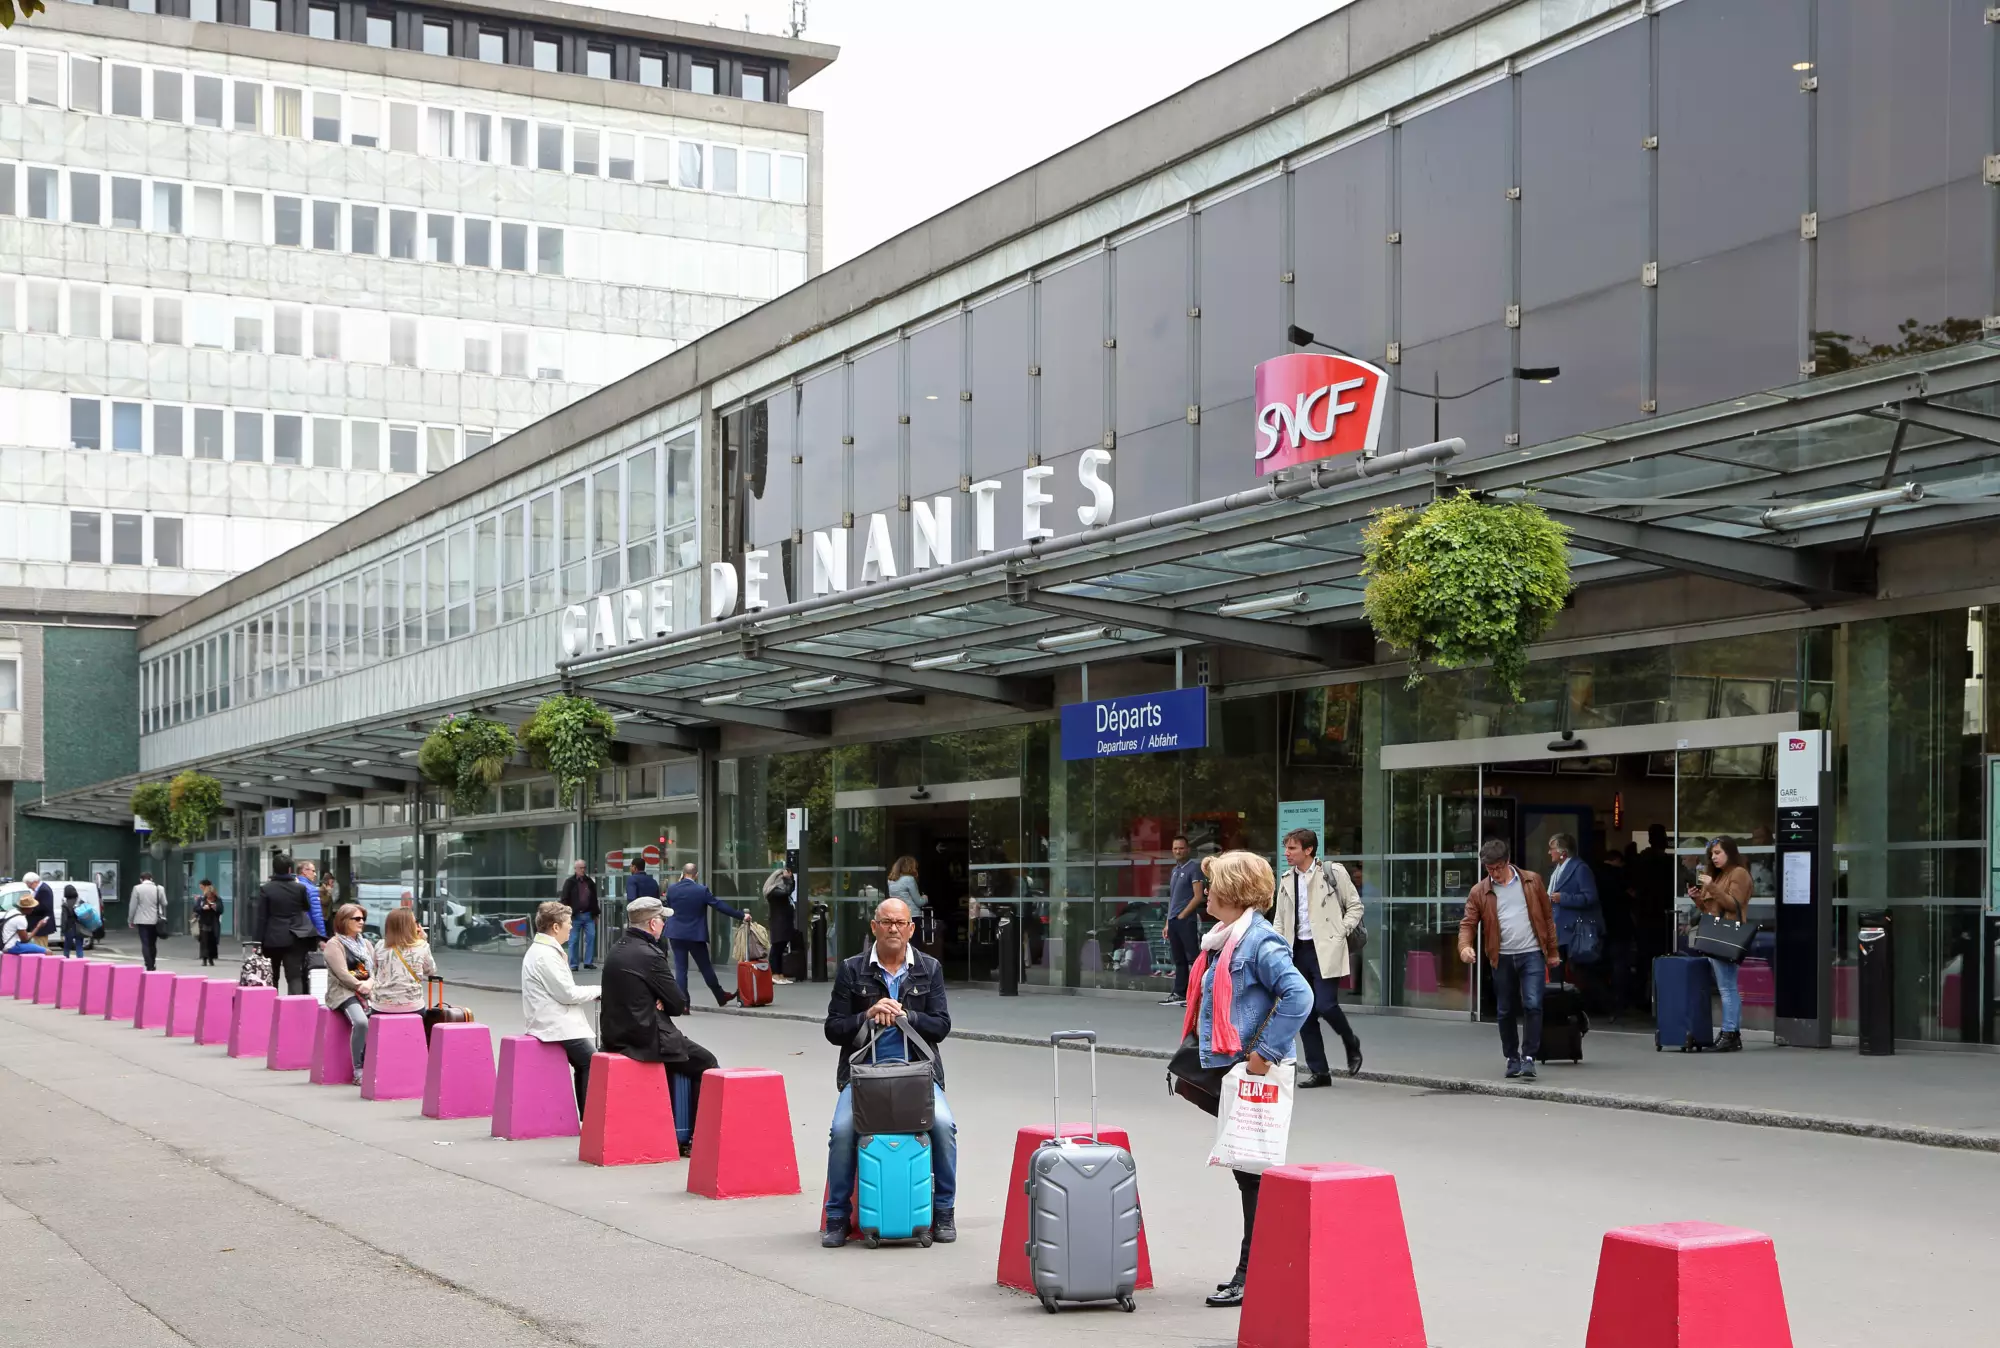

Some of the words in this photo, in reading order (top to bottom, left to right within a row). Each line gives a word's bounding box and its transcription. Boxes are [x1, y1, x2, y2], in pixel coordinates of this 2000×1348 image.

[1255, 377, 1366, 459] SNCF
[562, 579, 673, 656] GARE
[710, 549, 769, 618] DE
[813, 449, 1114, 592] NANTES
[1096, 702, 1162, 736] Départs
[1097, 740, 1138, 755] Departures
[1148, 733, 1178, 748] Abfahrt
[1789, 742, 1806, 750] SNCF
[1780, 788, 1797, 796] GARE
